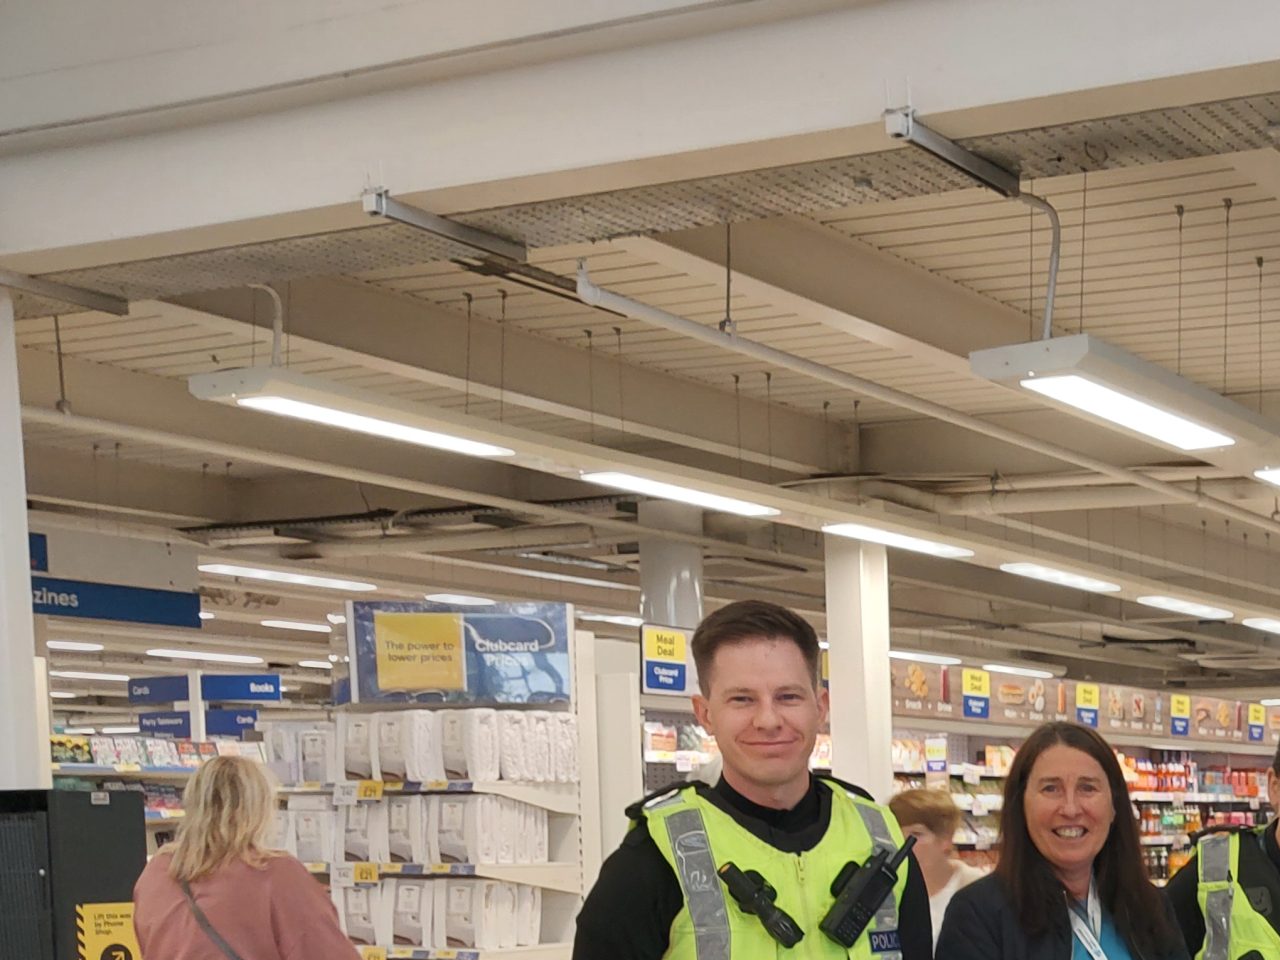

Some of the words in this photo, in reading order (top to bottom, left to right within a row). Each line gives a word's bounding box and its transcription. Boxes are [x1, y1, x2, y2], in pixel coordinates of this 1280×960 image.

[33, 586, 79, 608] zines
[656, 633, 676, 645] Meal
[385, 640, 405, 650] The
[407, 642, 440, 652] power
[443, 641, 455, 650] to
[475, 639, 540, 652] Clubcard
[657, 645, 675, 657] Deal
[388, 653, 418, 662] lower
[420, 653, 453, 664] prices
